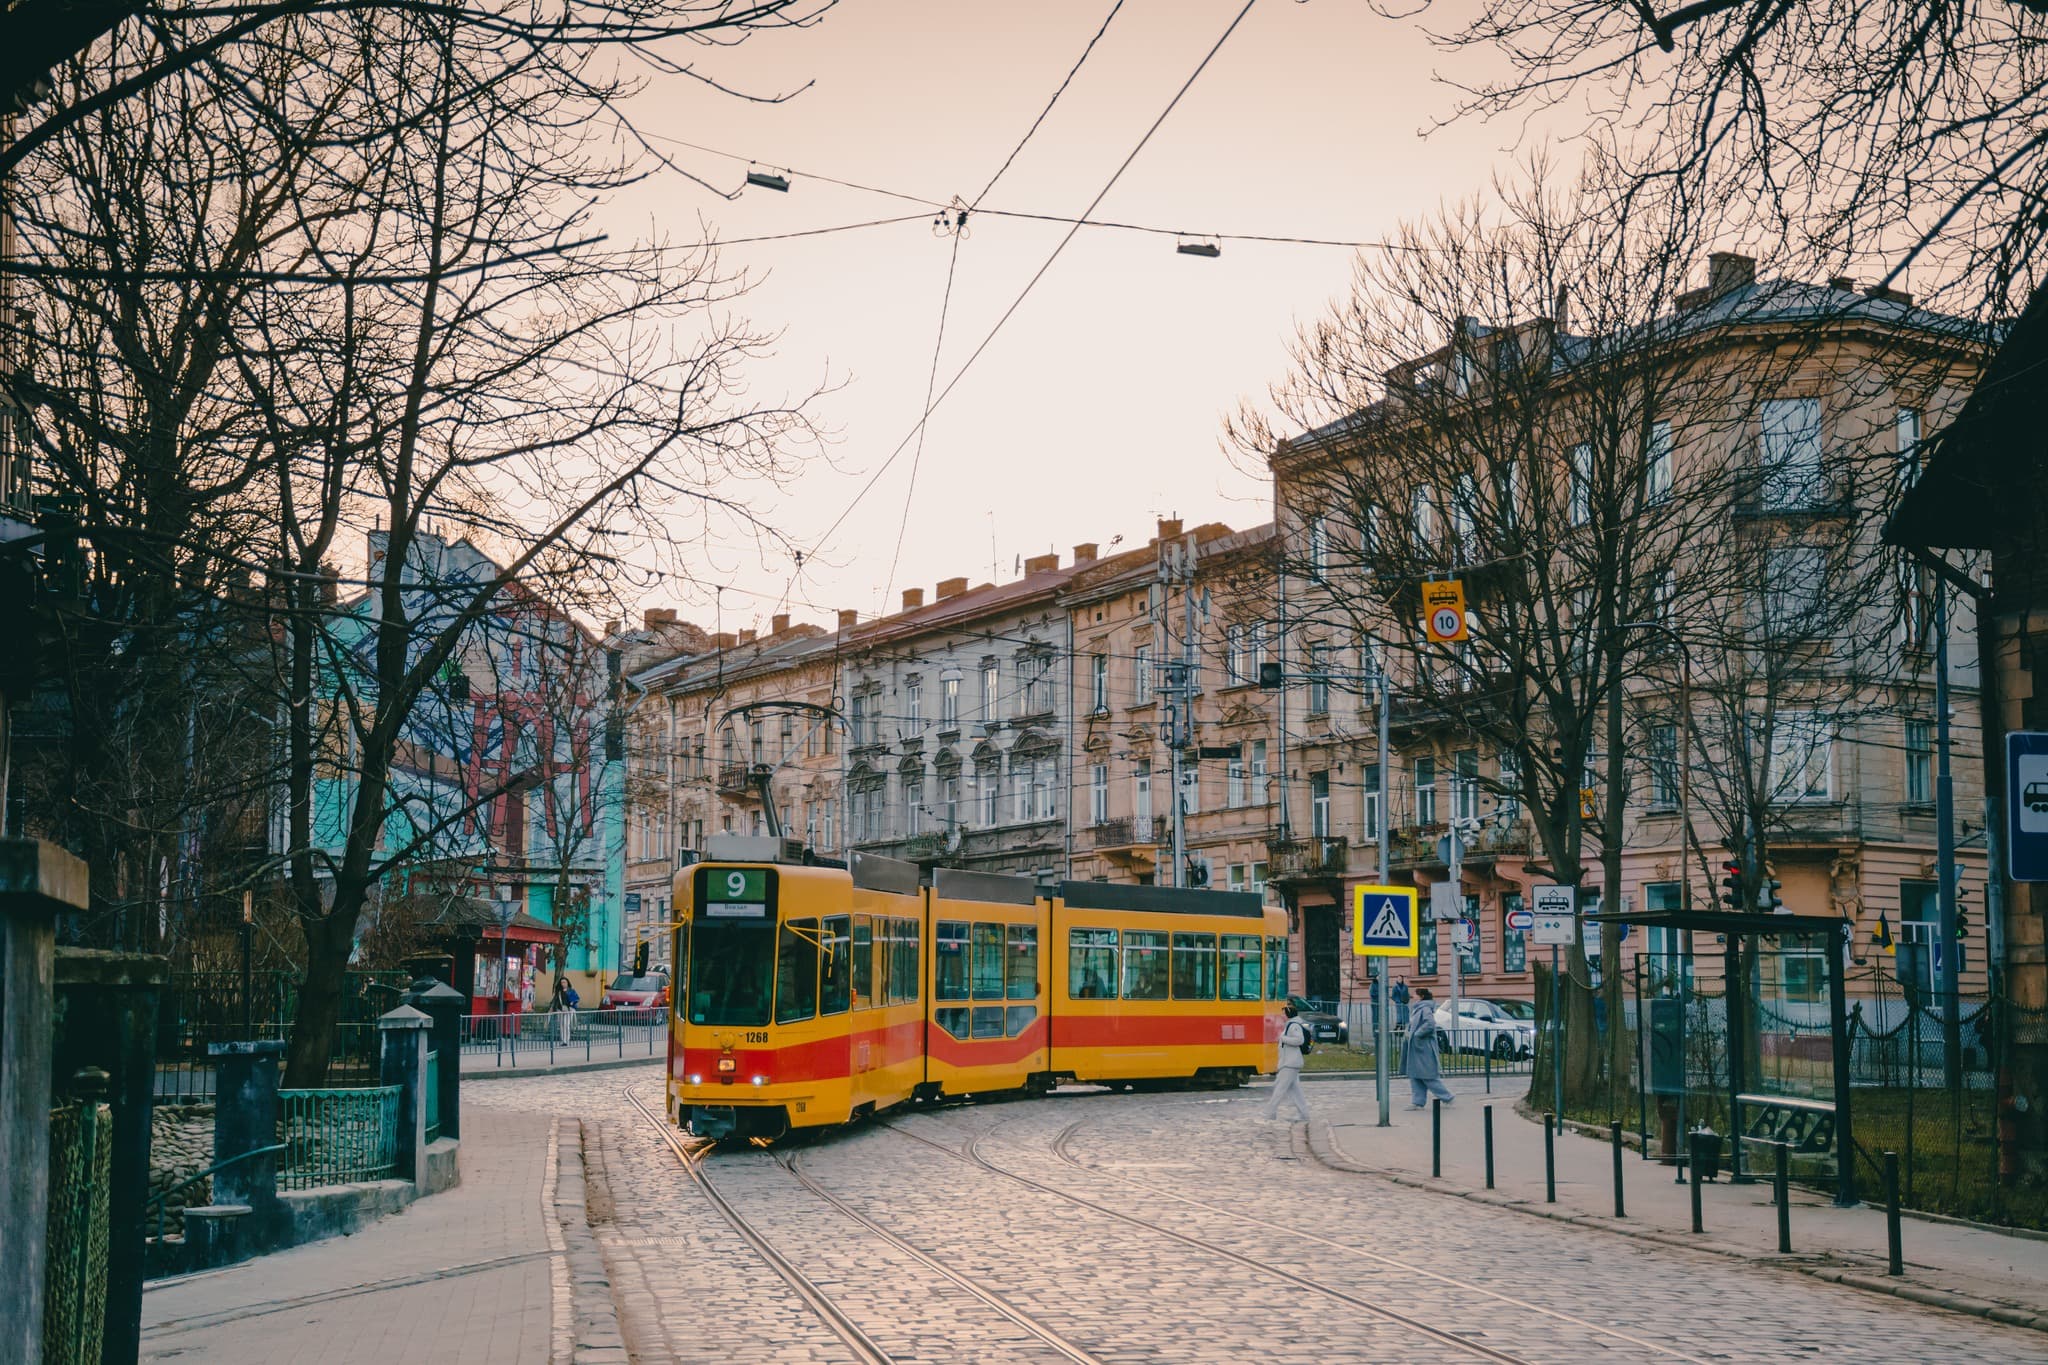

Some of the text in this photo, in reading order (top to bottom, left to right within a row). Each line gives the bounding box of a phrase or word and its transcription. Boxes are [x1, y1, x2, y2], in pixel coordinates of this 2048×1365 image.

[1439, 616, 1454, 629] 10
[727, 871, 746, 897] 9
[746, 1032, 768, 1043] 1268
